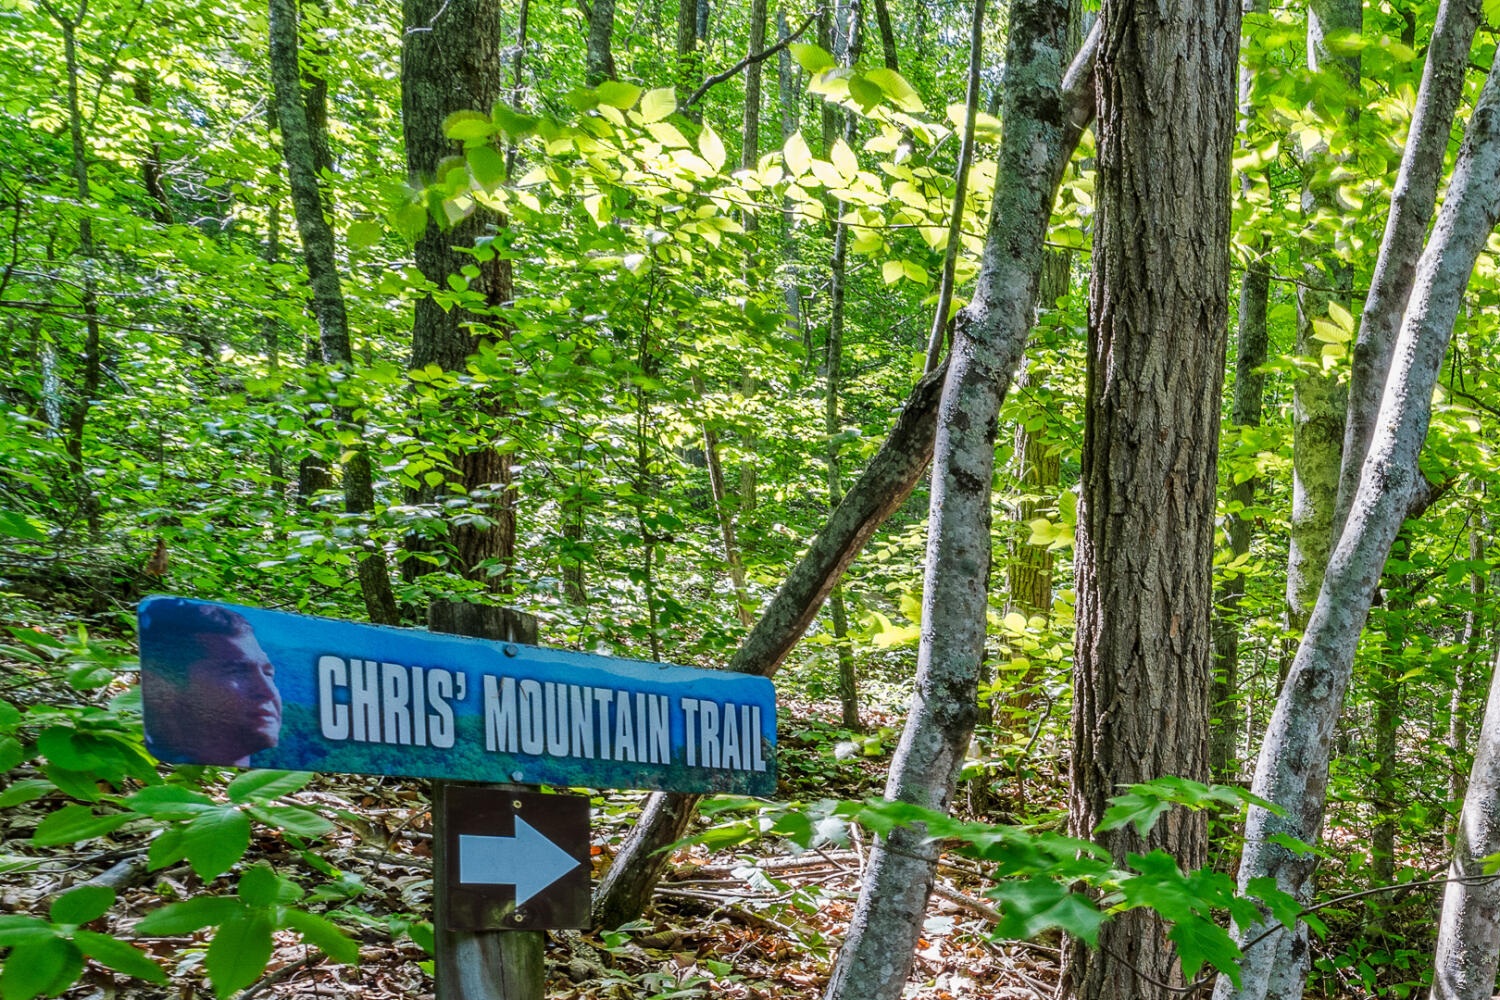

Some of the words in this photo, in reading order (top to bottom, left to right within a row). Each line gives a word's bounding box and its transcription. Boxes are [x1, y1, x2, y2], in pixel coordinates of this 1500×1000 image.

[318, 655, 467, 749] CHRIS'
[483, 674, 670, 765] MOUNTAIN
[682, 697, 767, 772] TRAIL
